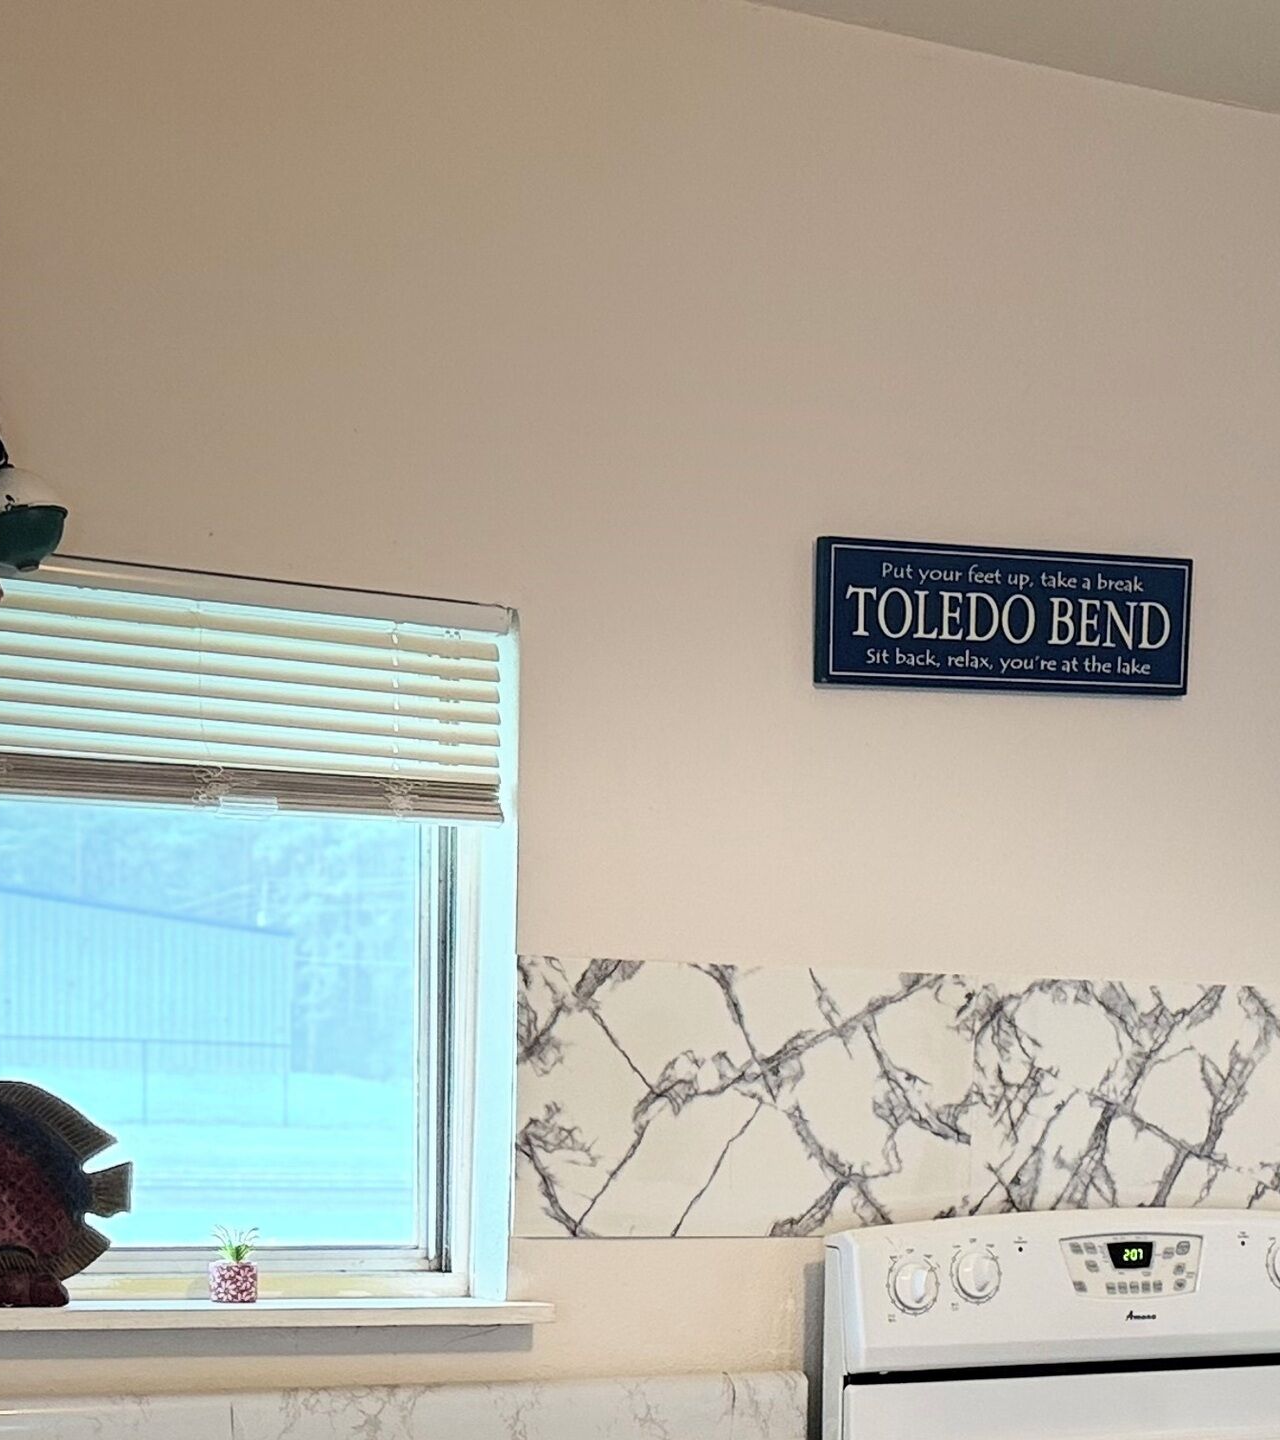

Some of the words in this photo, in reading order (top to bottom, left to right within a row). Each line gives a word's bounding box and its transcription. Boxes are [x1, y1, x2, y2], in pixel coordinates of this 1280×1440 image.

[882, 563, 913, 580] Put
[919, 569, 963, 585] your
[968, 565, 1001, 585] feet
[1008, 573, 1034, 589] up,
[1041, 572, 1078, 589] take
[1082, 578, 1091, 590] a
[1097, 574, 1144, 593] break
[846, 584, 1036, 644] TOLEDO
[1048, 597, 1171, 651] BEND
[867, 648, 889, 664] Sit
[895, 649, 940, 667] back,
[948, 651, 993, 671] relax,
[1000, 655, 1056, 674] you're
[1062, 658, 1079, 673] at
[1083, 658, 1111, 674] the
[1117, 657, 1151, 675] lake
